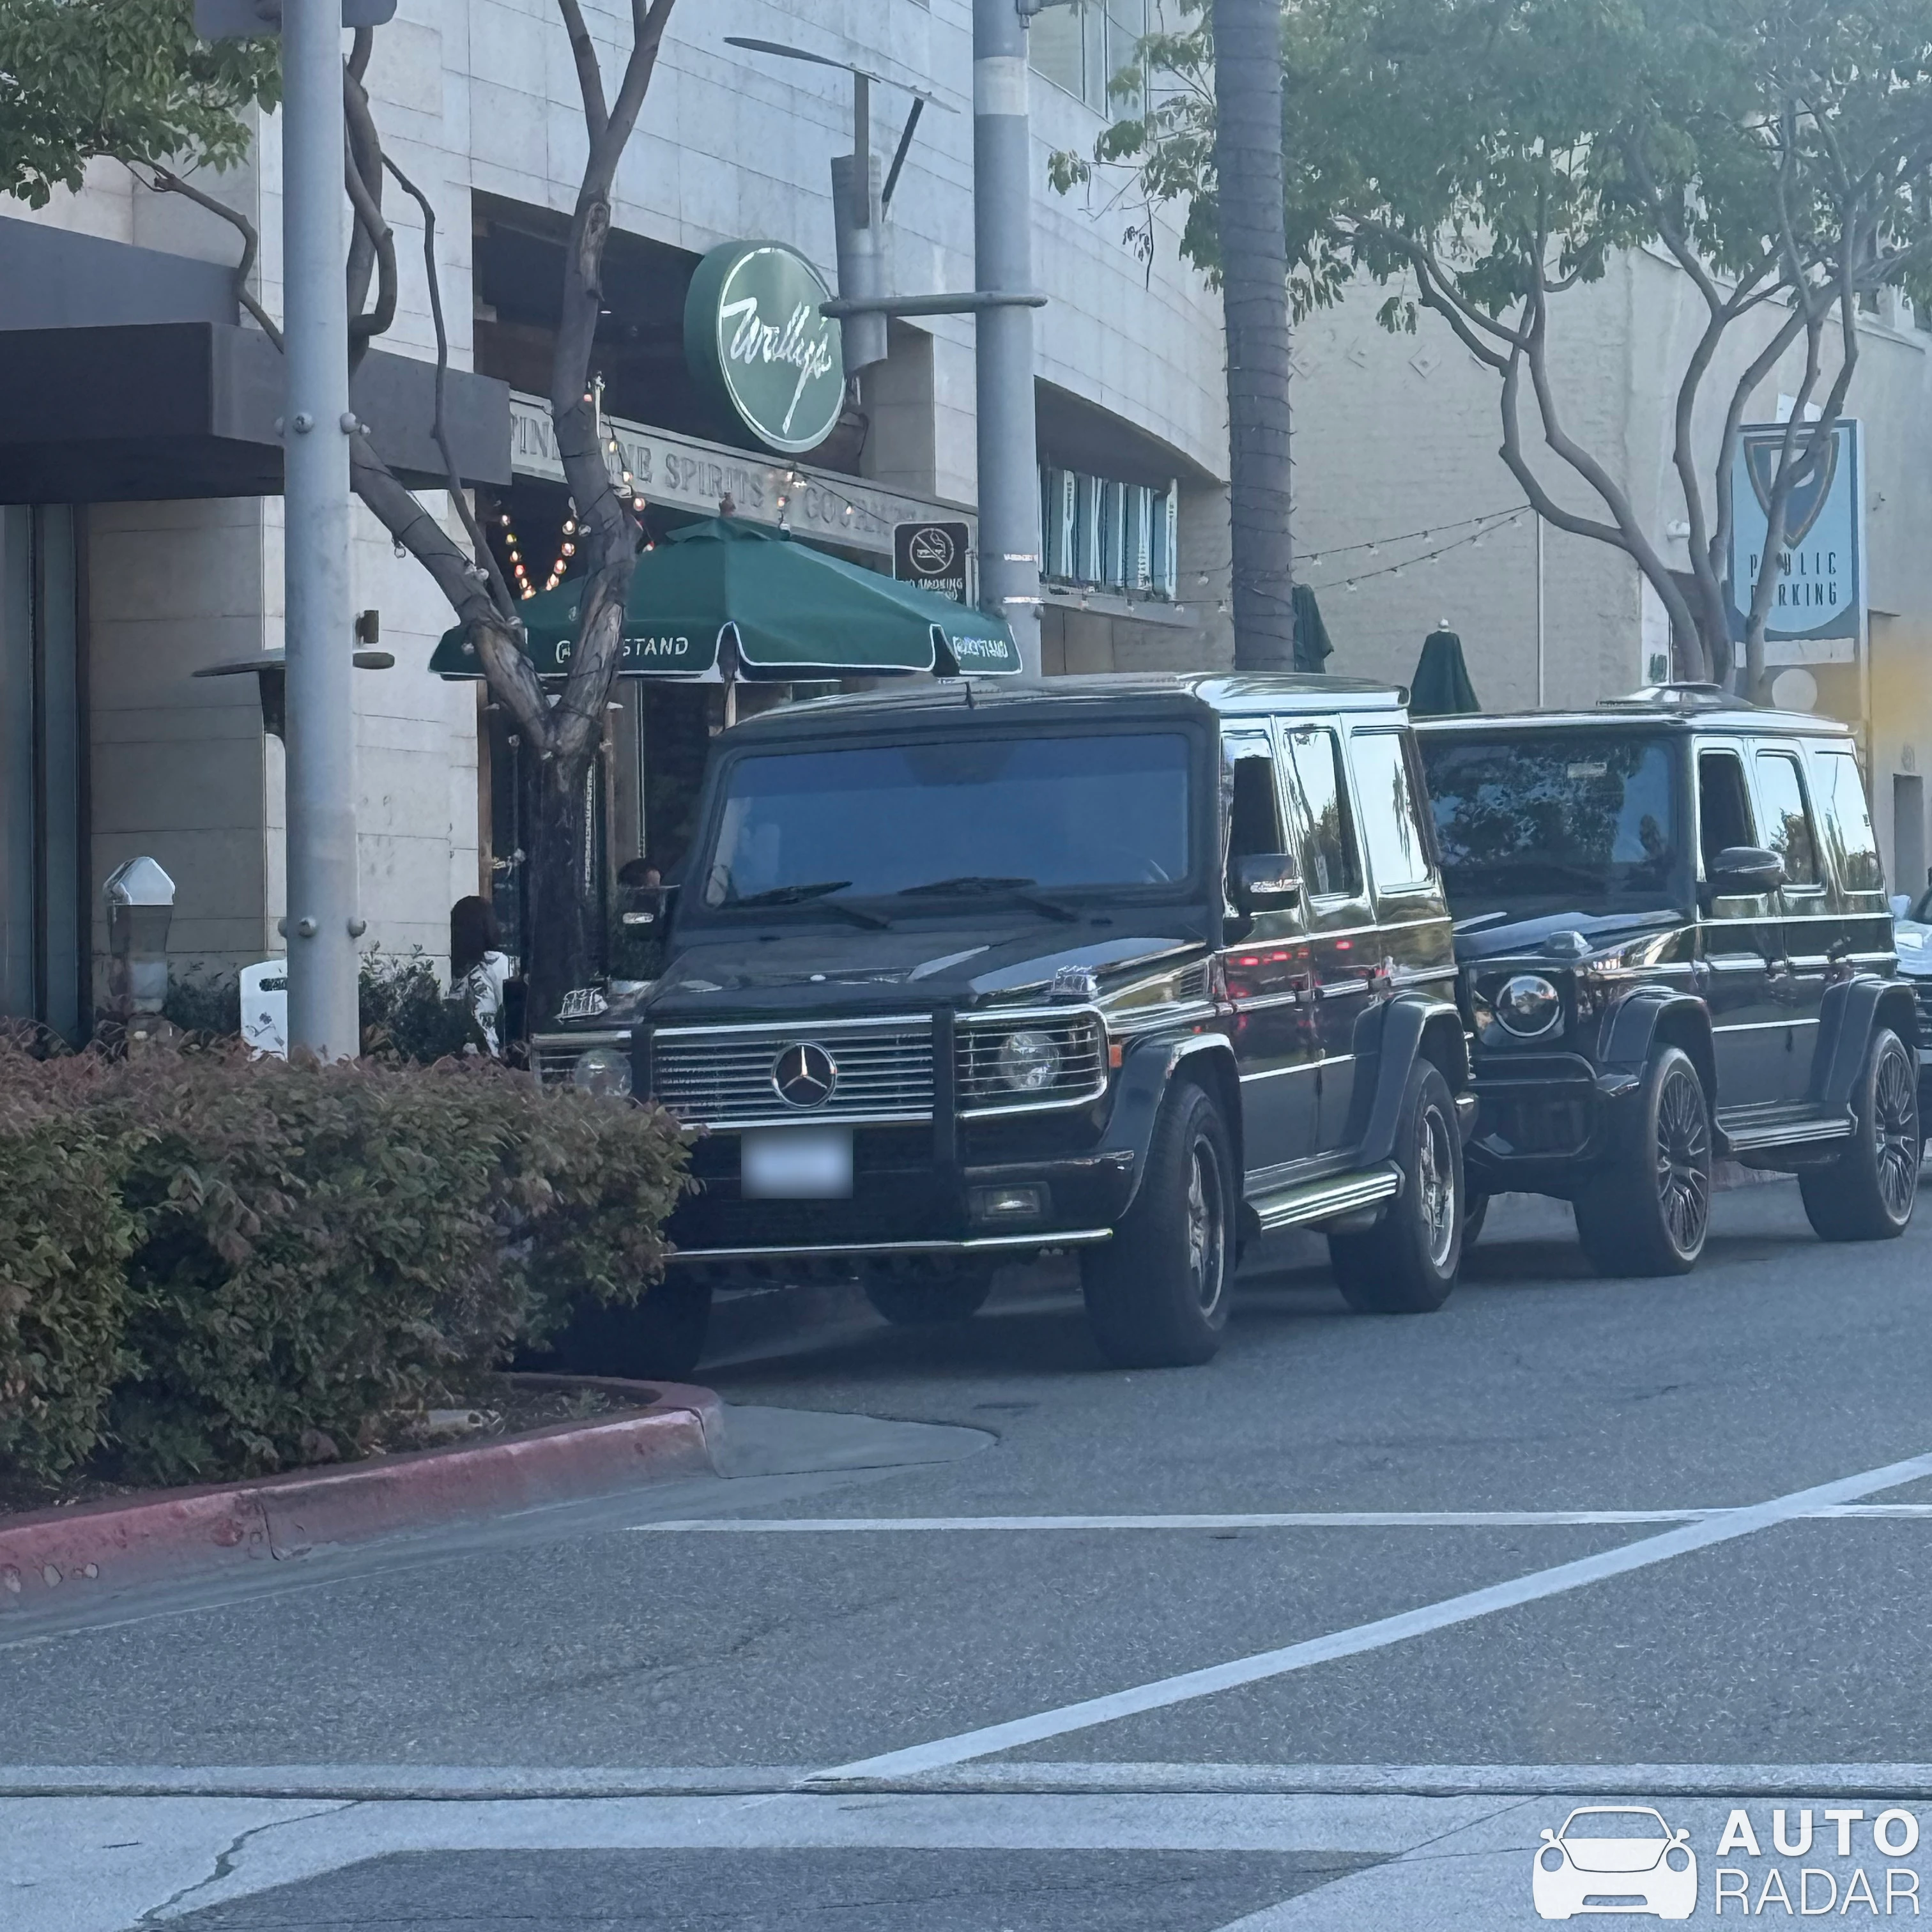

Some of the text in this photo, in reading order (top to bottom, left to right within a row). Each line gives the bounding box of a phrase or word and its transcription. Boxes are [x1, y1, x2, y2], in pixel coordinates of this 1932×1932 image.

[722, 296, 832, 433] Wally's
[666, 452, 764, 509] SPIRITS
[1751, 581, 1837, 607] PRKING
